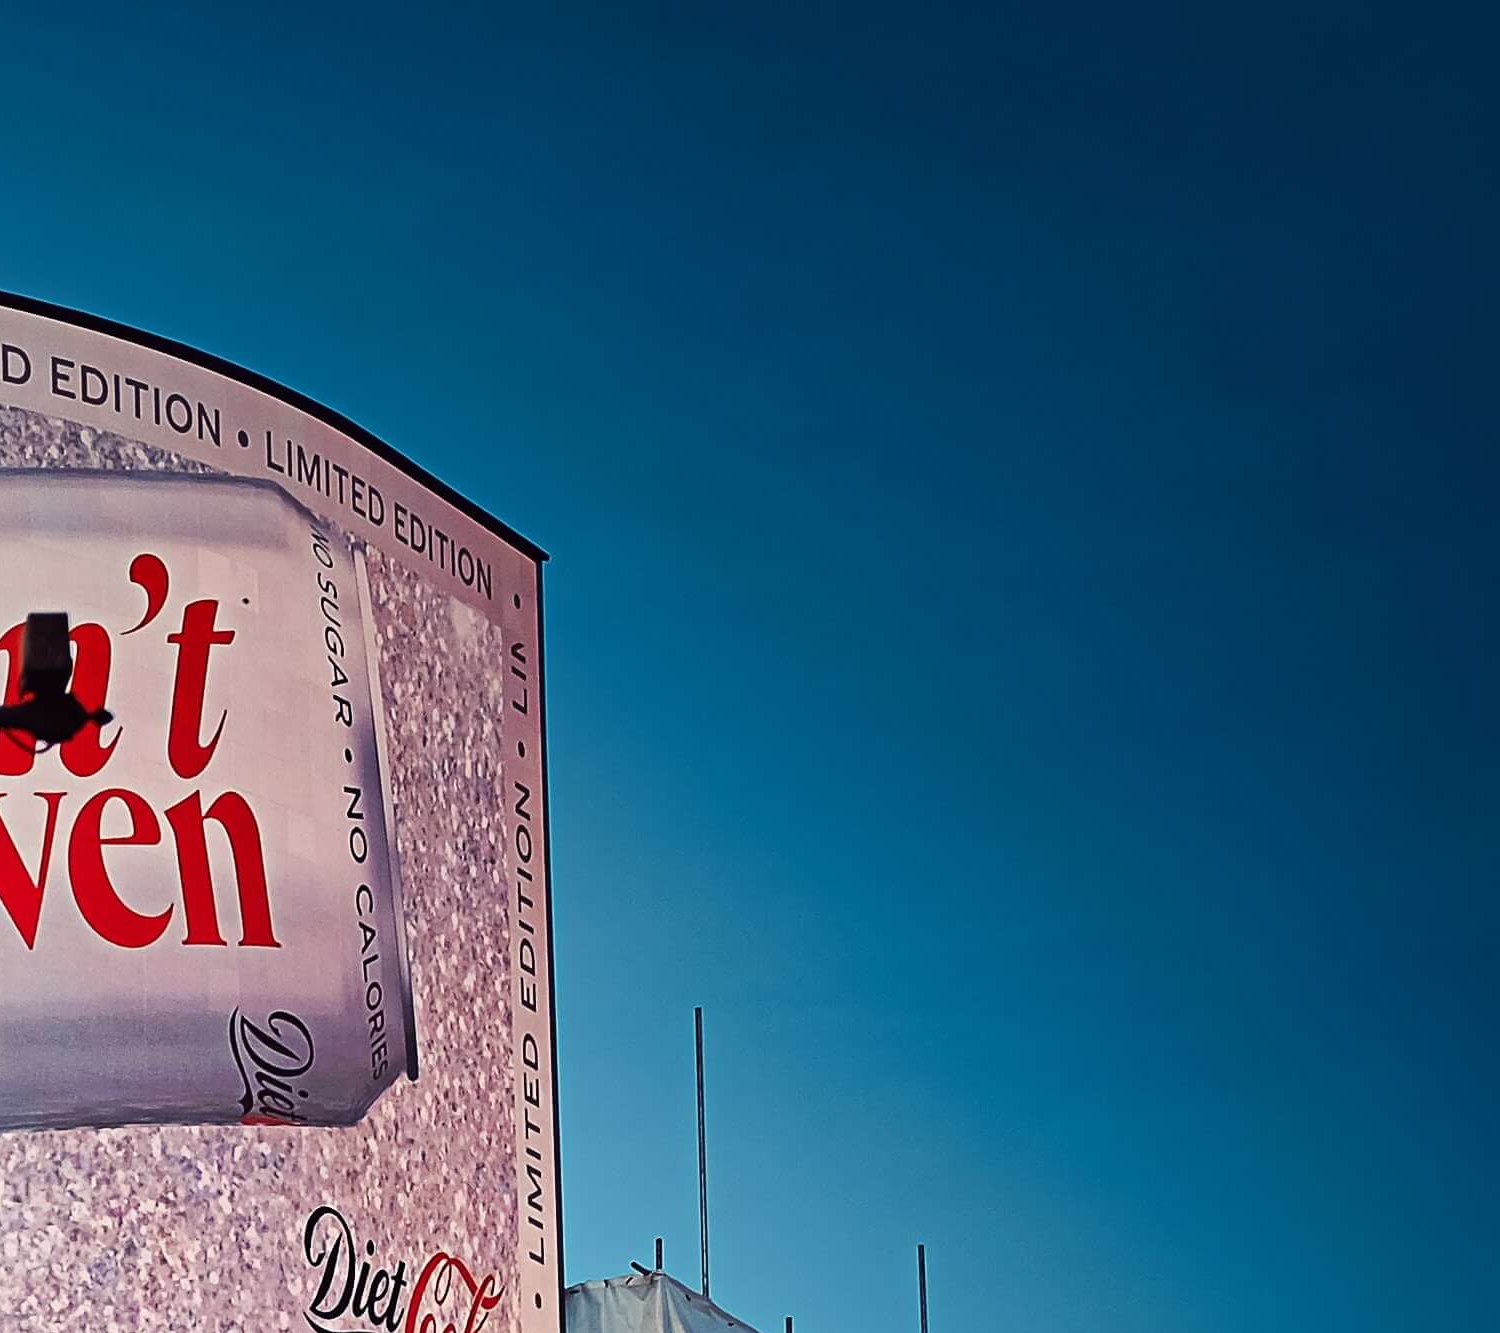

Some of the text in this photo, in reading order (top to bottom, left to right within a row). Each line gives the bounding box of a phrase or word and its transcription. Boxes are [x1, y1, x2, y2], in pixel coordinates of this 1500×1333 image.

[50, 355, 222, 447] EDITION
[265, 430, 385, 527] LIMITED
[393, 501, 493, 601] EDITION
[309, 521, 390, 1081] NO SUGAR NO CALORIES
[514, 782, 538, 1012] EDITION
[520, 1032, 545, 1266] LIMITED
